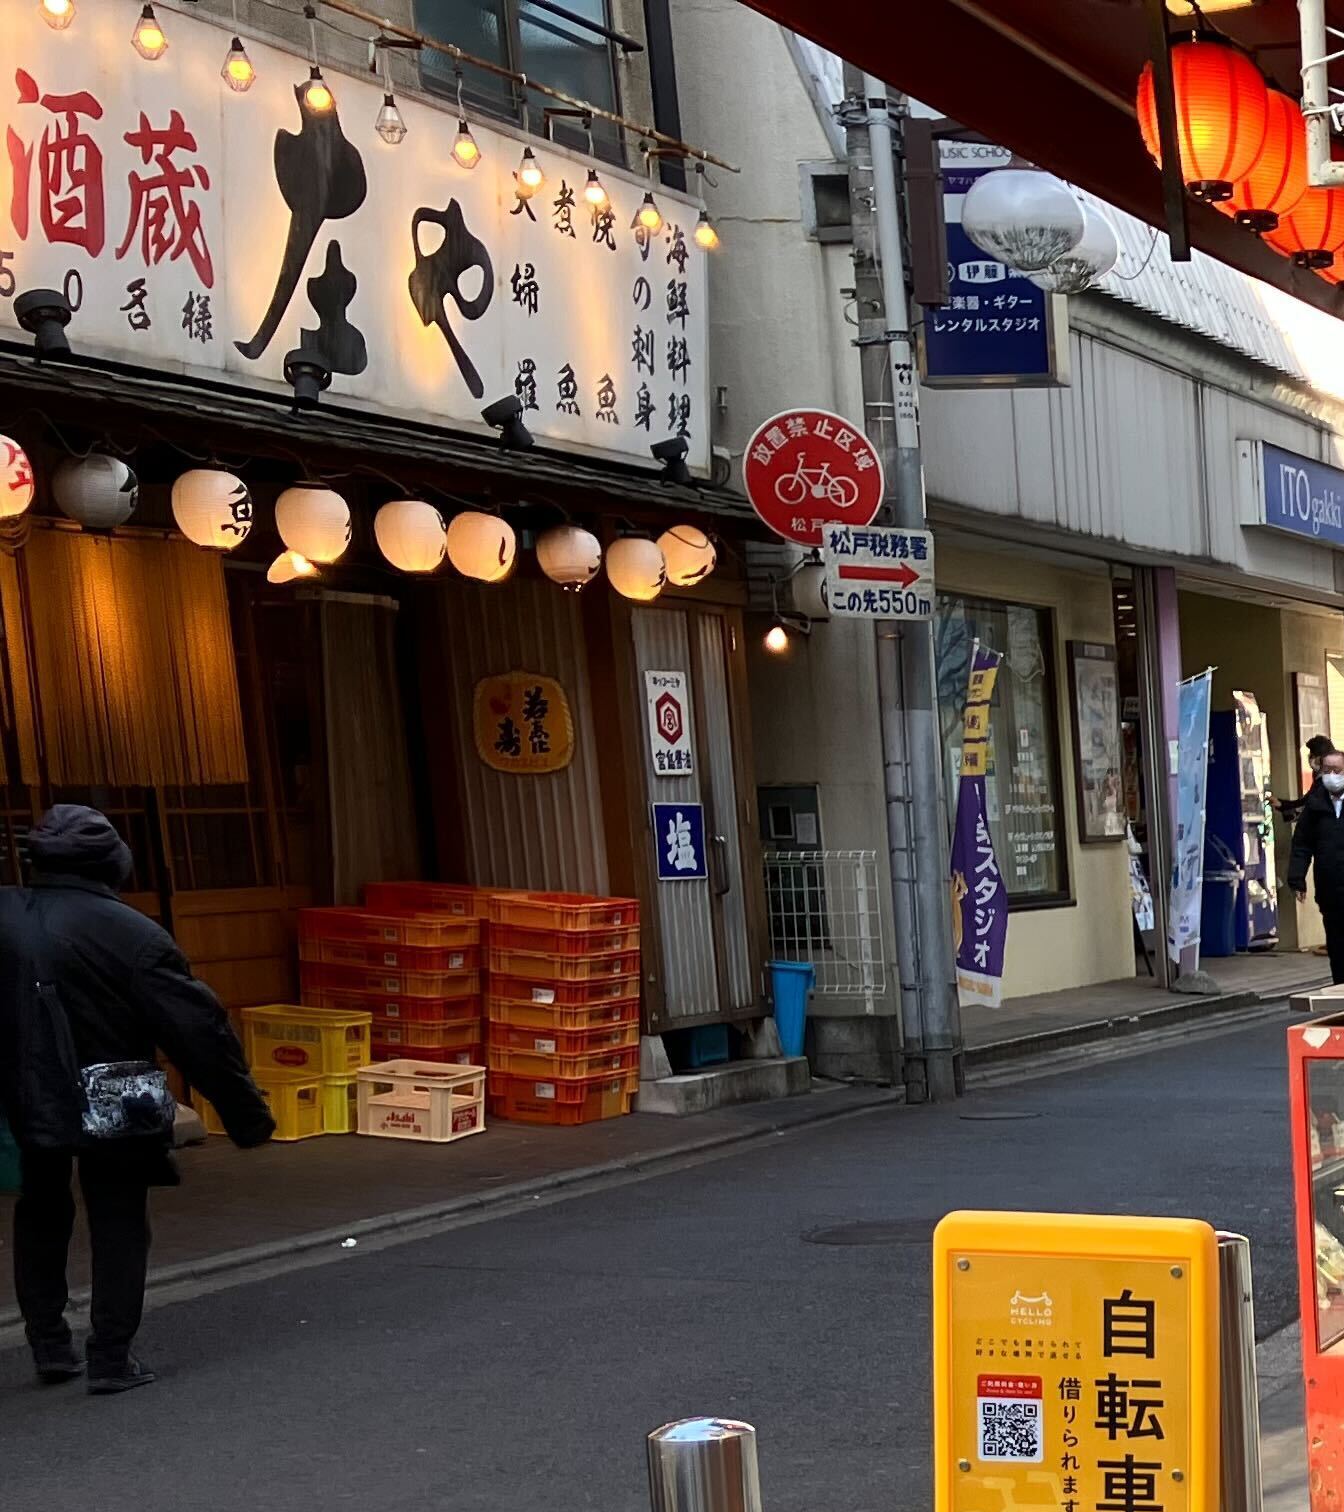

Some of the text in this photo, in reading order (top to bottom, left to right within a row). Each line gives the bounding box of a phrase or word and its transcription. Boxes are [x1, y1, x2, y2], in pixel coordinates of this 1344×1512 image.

[942, 147, 969, 159] USIC
[6, 67, 215, 289] 酒蔵
[940, 294, 1033, 310] 楽器・ギター
[665, 222, 692, 439] 海鮮料理
[751, 416, 876, 472] 放置禁止区域
[829, 528, 928, 561] 松戸税務署
[832, 588, 931, 616] この先550m
[666, 811, 698, 871] 塩
[1010, 1307, 1053, 1317] HELLO
